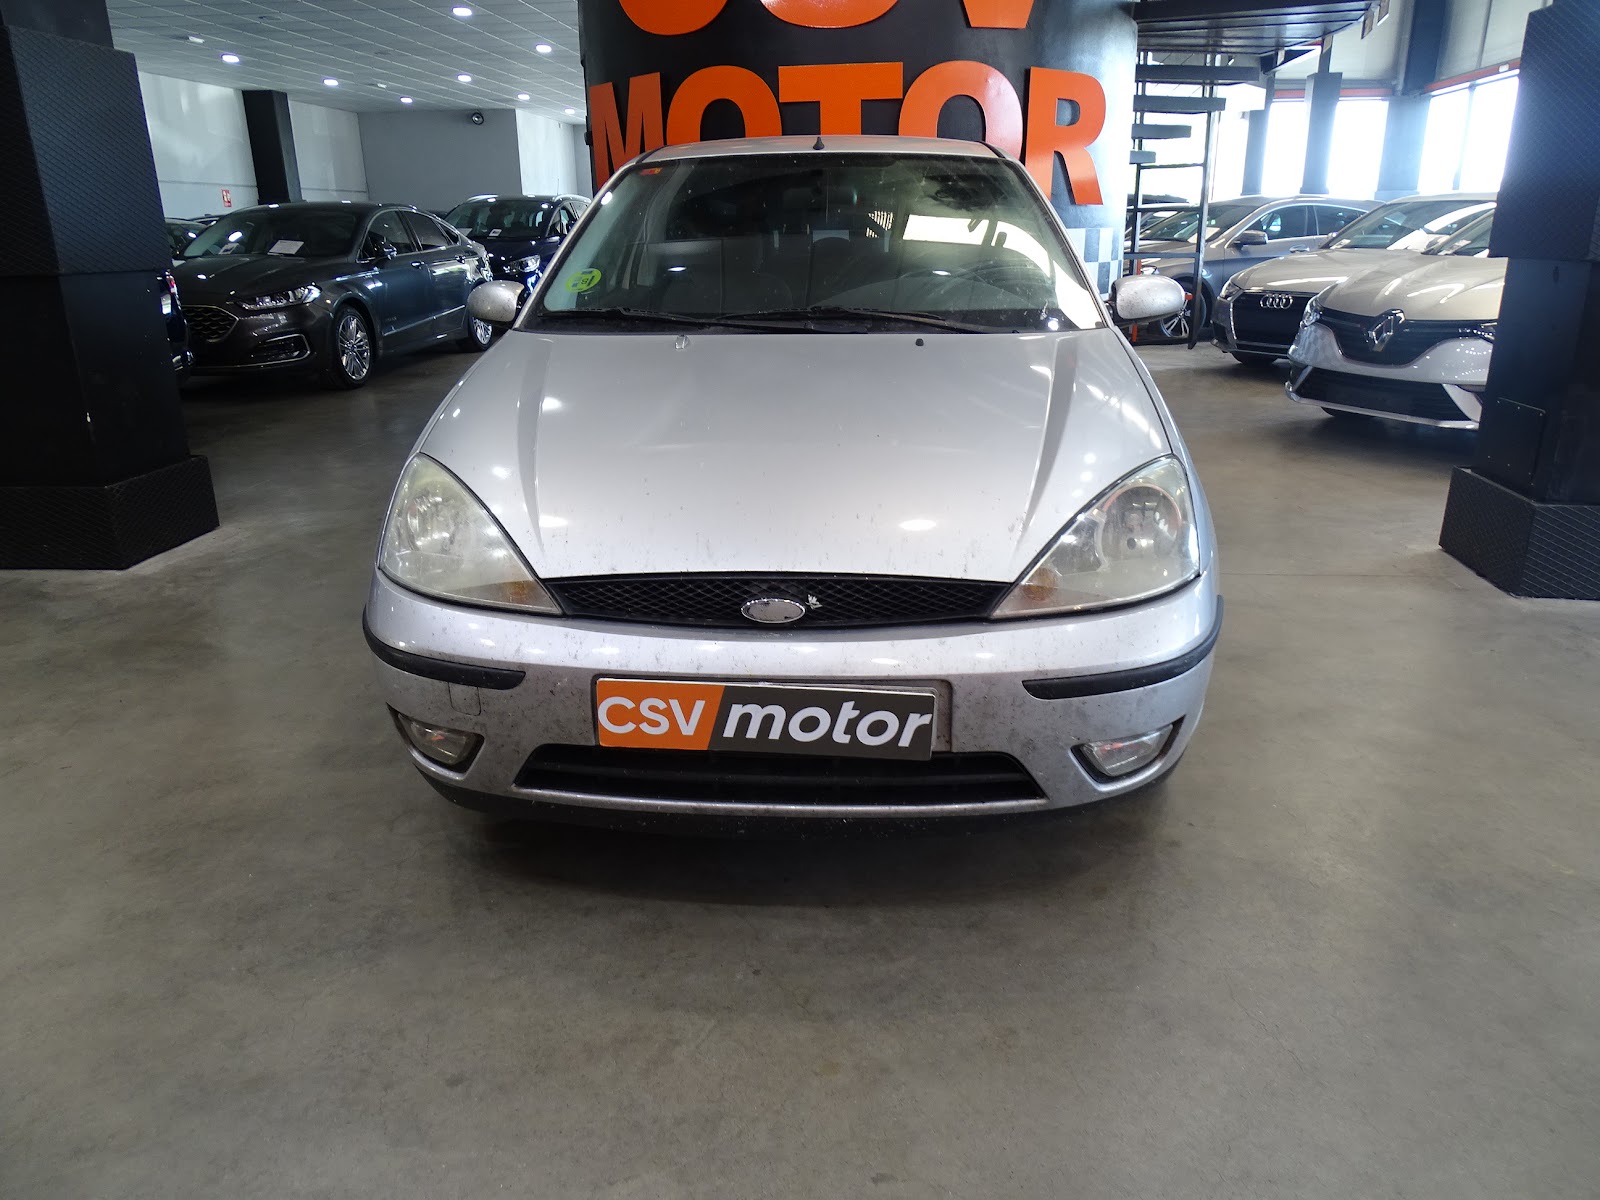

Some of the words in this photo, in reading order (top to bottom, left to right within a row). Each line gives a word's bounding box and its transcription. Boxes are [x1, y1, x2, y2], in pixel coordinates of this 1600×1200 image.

[590, 60, 1106, 205] MOTOR
[597, 696, 706, 736] CSV
[722, 700, 933, 748] motor
